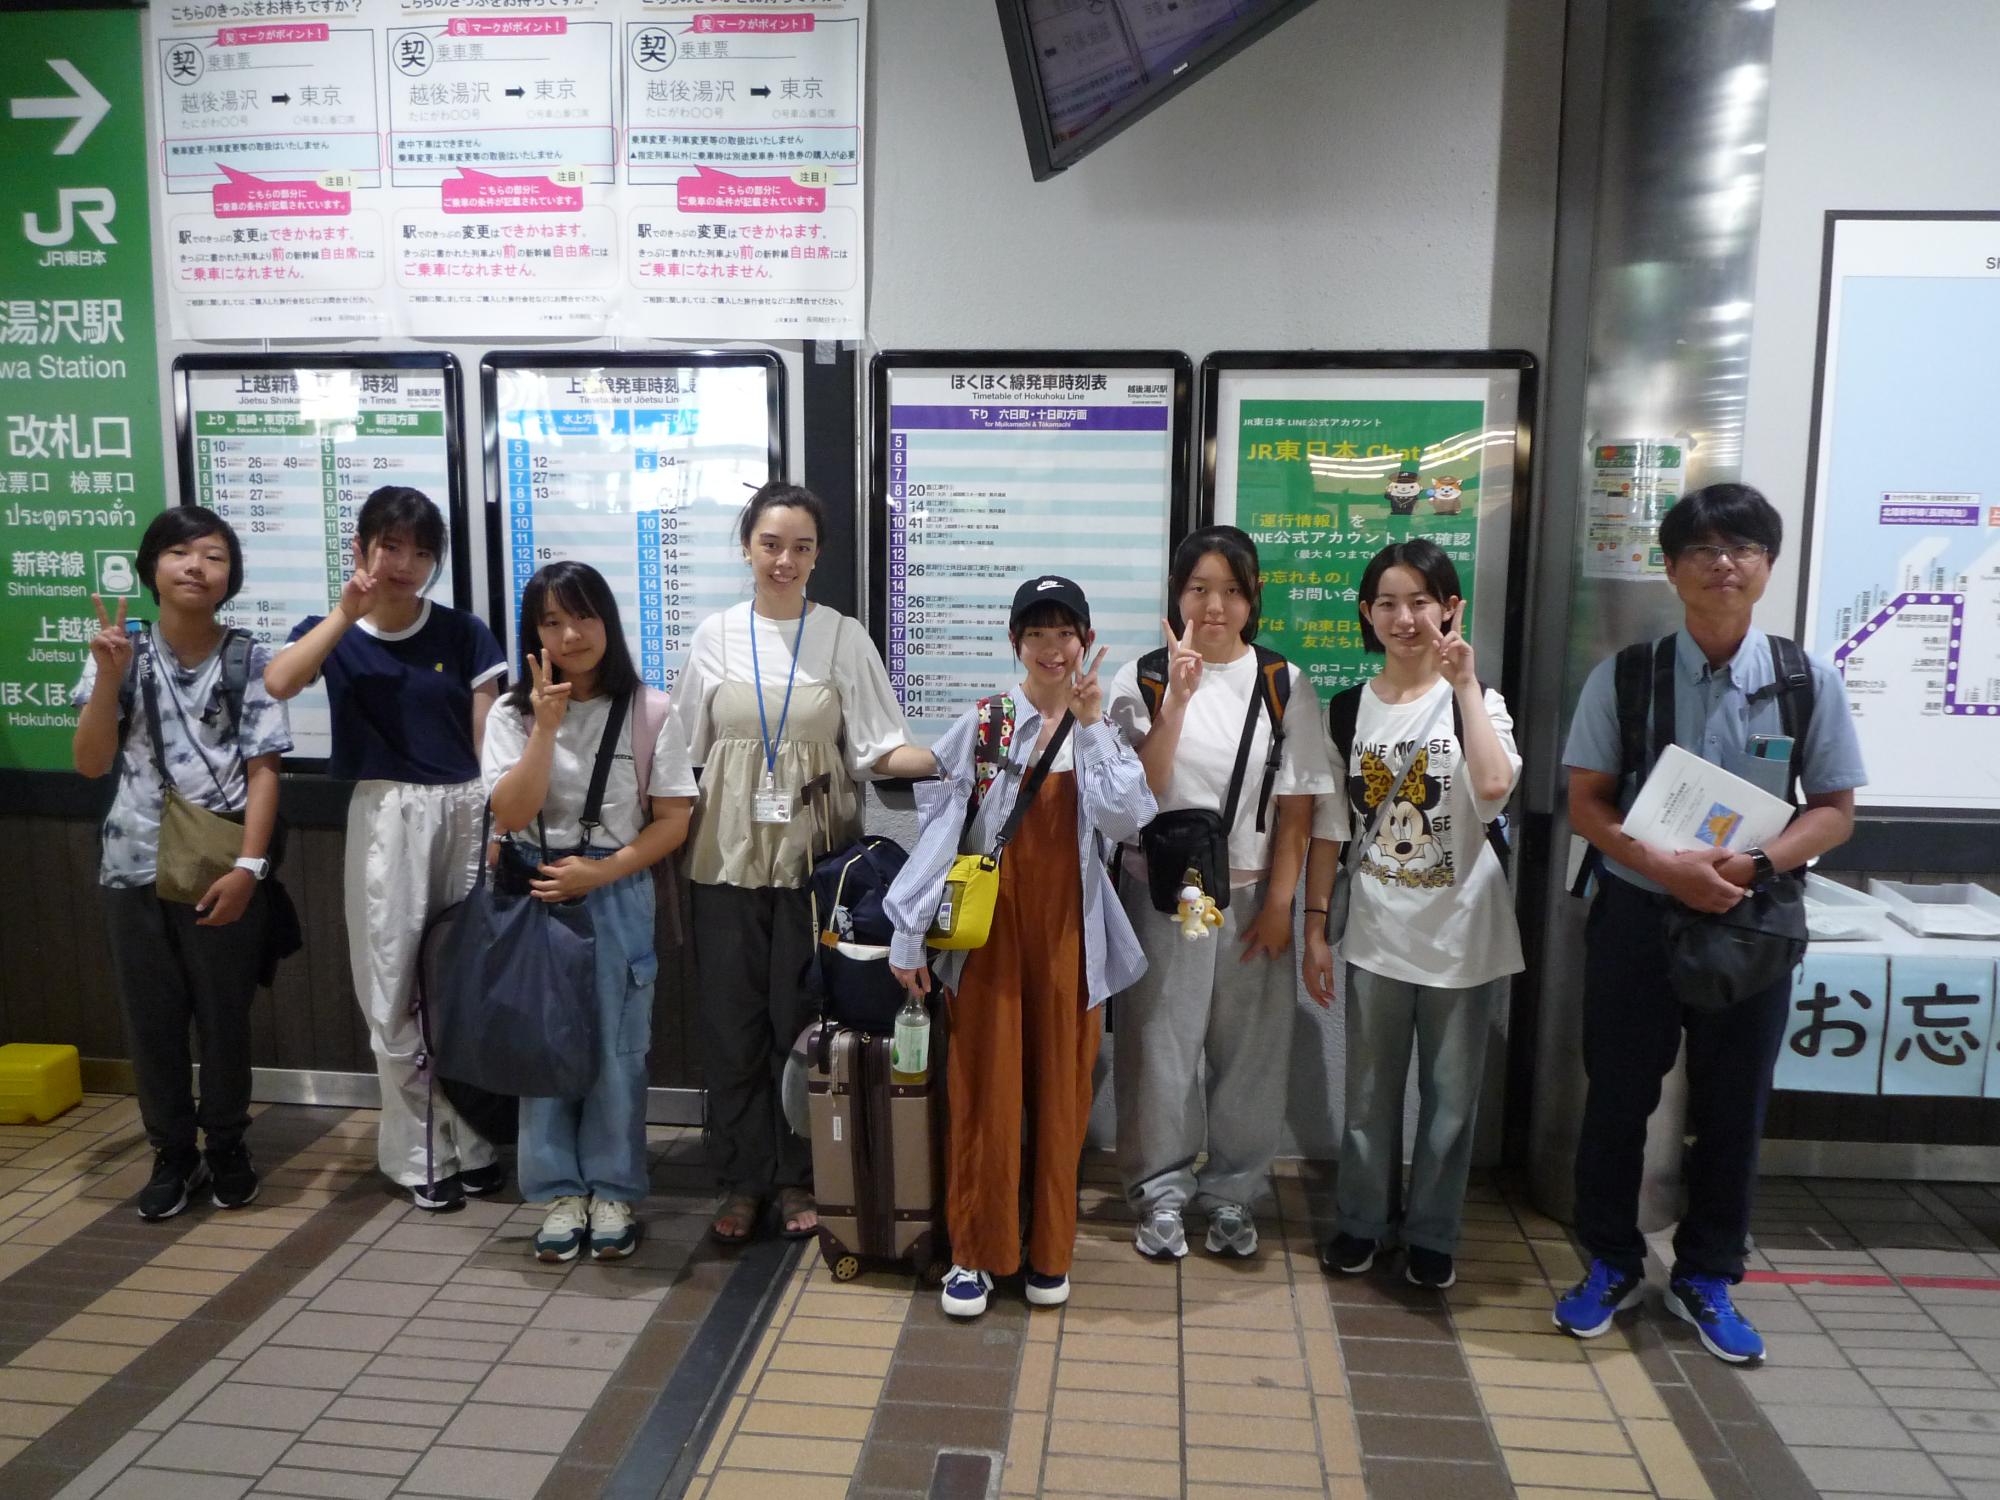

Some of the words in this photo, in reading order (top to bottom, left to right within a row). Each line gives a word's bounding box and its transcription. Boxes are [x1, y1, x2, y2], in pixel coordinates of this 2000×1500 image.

[401, 40, 426, 68] 契
[640, 34, 666, 63] 契
[173, 51, 197, 77] 契
[409, 81, 492, 106] 越後湯沢
[534, 78, 577, 100] 東京
[647, 80, 735, 103] 越後湯沢
[780, 77, 824, 99] 東京
[181, 89, 258, 113] 越後湯沢
[299, 85, 342, 107] 東京
[23, 187, 119, 247] JR
[39, 250, 107, 267] JR東日本
[39, 354, 126, 379] Station
[951, 374, 1107, 391] ほくほく線発車時刻表
[973, 392, 1012, 400] Timetable
[1013, 392, 1022, 400] of
[1024, 392, 1065, 400] Hokuhoku
[1067, 392, 1085, 400] Line
[969, 409, 988, 420] 下り
[999, 409, 1087, 420] 六日町・十日町方面
[1243, 418, 1285, 426] JR東日本
[1288, 418, 1382, 427] LINE公式アカウント
[7, 414, 132, 459] 改札口
[213, 441, 226, 452] 10
[214, 457, 227, 468] 15
[248, 457, 262, 468] 26
[283, 457, 297, 468] 49
[337, 457, 351, 468] 03
[373, 458, 388, 468] 23
[533, 457, 548, 468] 12
[660, 457, 675, 467] 34
[215, 474, 226, 484] 11
[249, 474, 263, 484] 43
[339, 474, 350, 484] 11
[533, 472, 548, 483] 27
[216, 490, 228, 500] 14
[250, 490, 263, 500] 27
[339, 490, 352, 501] 06
[534, 488, 549, 498] 13
[908, 485, 925, 496] 20
[251, 505, 264, 516] 33
[340, 506, 352, 516] 21
[251, 521, 265, 532] 33
[661, 518, 677, 529] 30
[892, 518, 904, 528] 10
[909, 518, 923, 529] 41
[662, 534, 678, 545] 23
[893, 534, 903, 544] 11
[909, 534, 923, 545] 41
[537, 548, 552, 559] 16
[664, 549, 678, 560] 14
[12, 551, 86, 578] 新幹線
[664, 564, 678, 575] 14
[892, 565, 904, 576] 13
[908, 565, 925, 576] 26
[8, 582, 87, 598] Shinkansen
[664, 579, 679, 590] 16
[892, 581, 904, 591] 14
[665, 594, 679, 606] 12
[892, 597, 904, 607] 15
[908, 596, 924, 607] 26
[257, 601, 269, 612] 18
[665, 609, 680, 621] 10
[892, 613, 904, 623] 16
[907, 612, 924, 623] 23
[257, 616, 269, 627] 41
[666, 625, 680, 636] 18
[892, 628, 904, 638] 17
[909, 628, 924, 639] 10
[666, 640, 679, 650] 51
[892, 644, 904, 654] 18
[907, 644, 924, 655] 06
[892, 660, 904, 670] 19
[907, 675, 924, 686] 06
[907, 690, 922, 702] 01
[907, 706, 924, 717] 24
